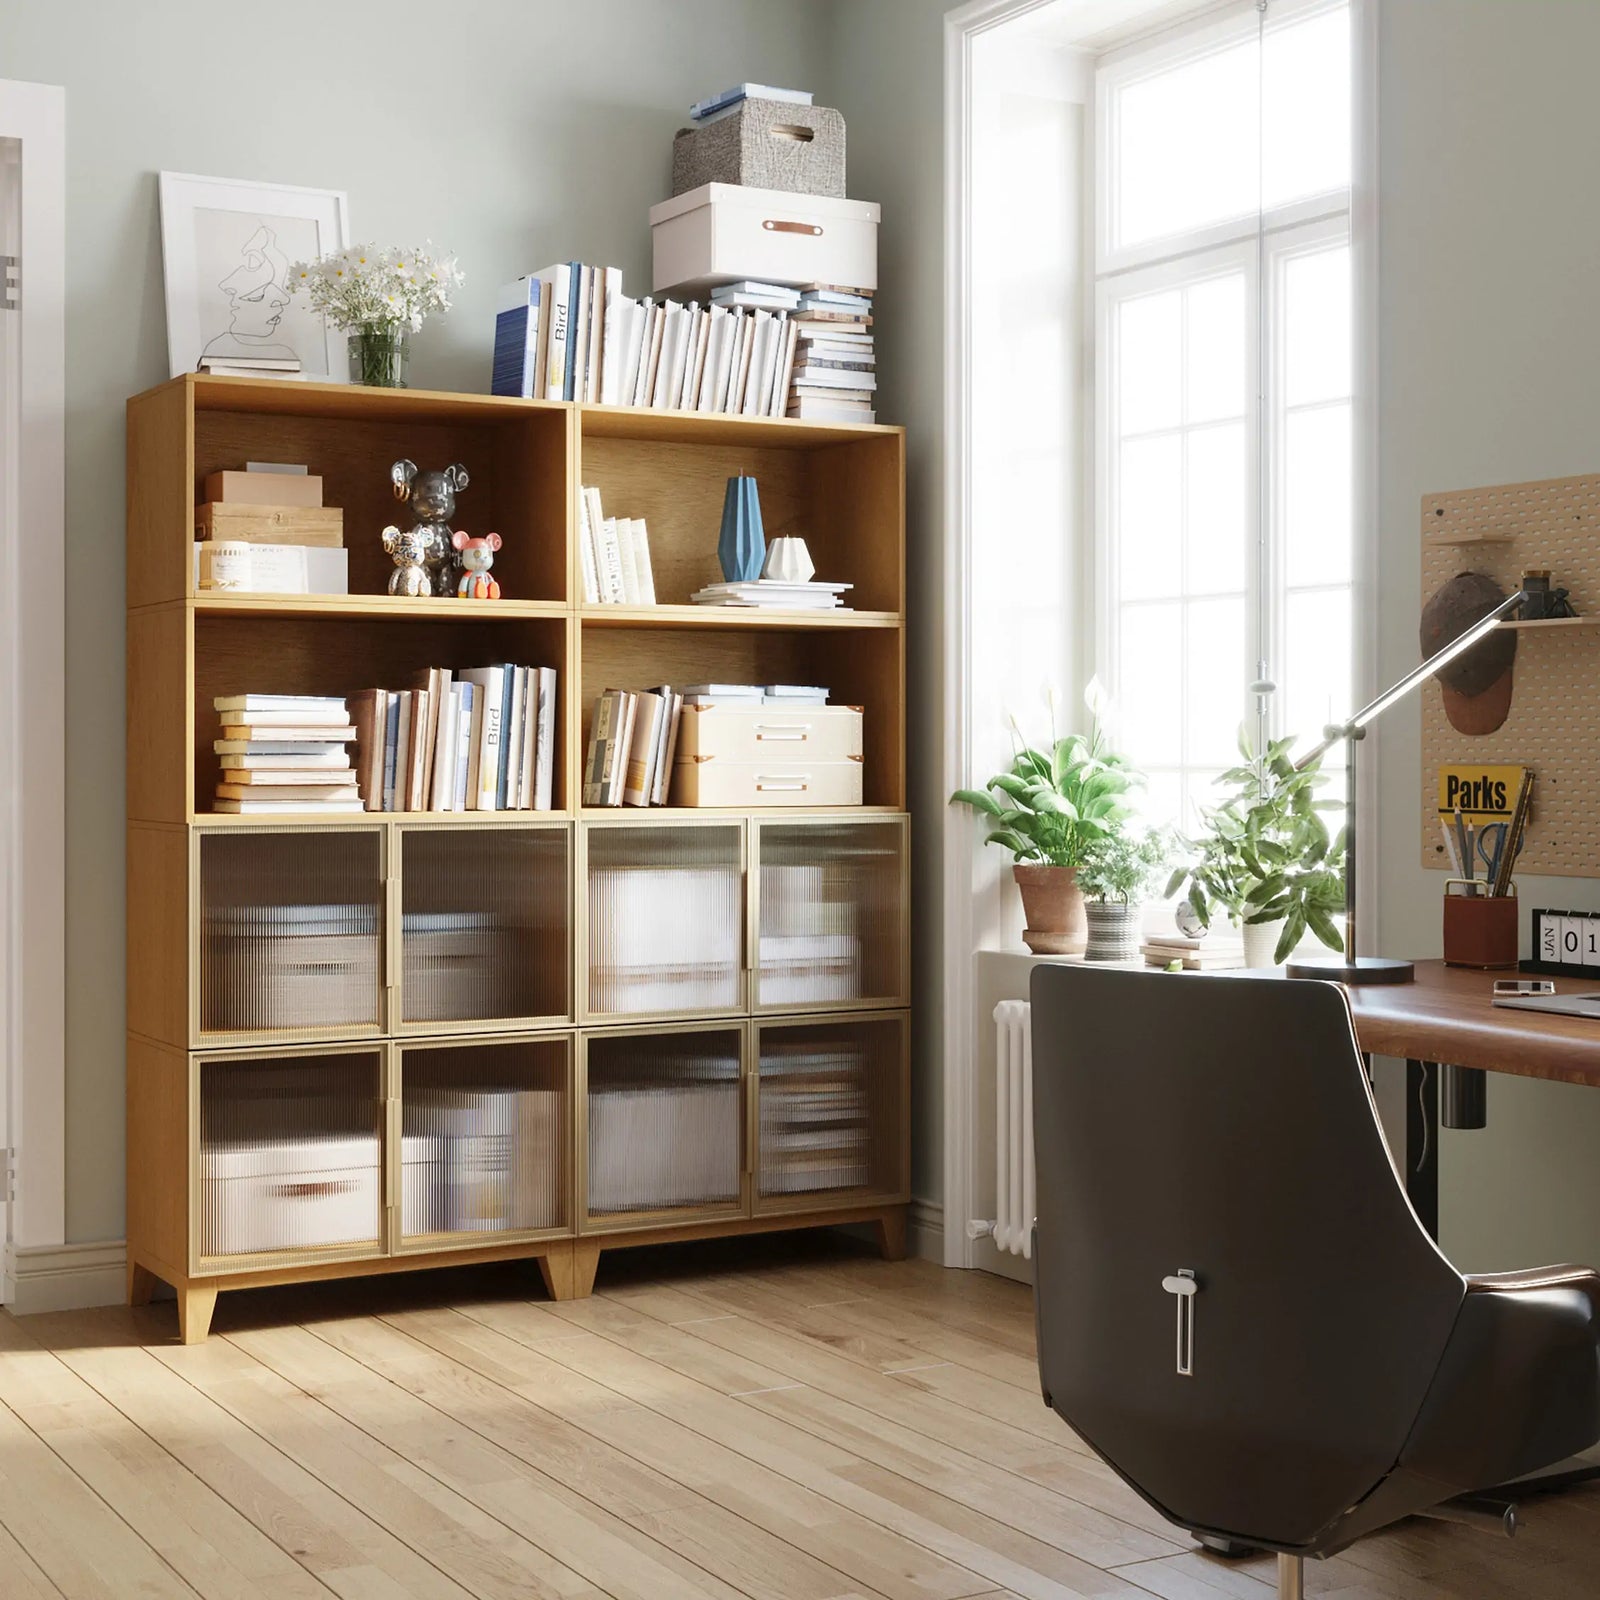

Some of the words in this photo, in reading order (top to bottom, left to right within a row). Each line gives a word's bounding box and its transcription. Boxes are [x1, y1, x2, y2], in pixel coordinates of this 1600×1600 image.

[555, 304, 566, 341] Bird
[488, 708, 499, 745] Bird
[1447, 775, 1506, 810] Parks
[1544, 927, 1555, 957] JAN
